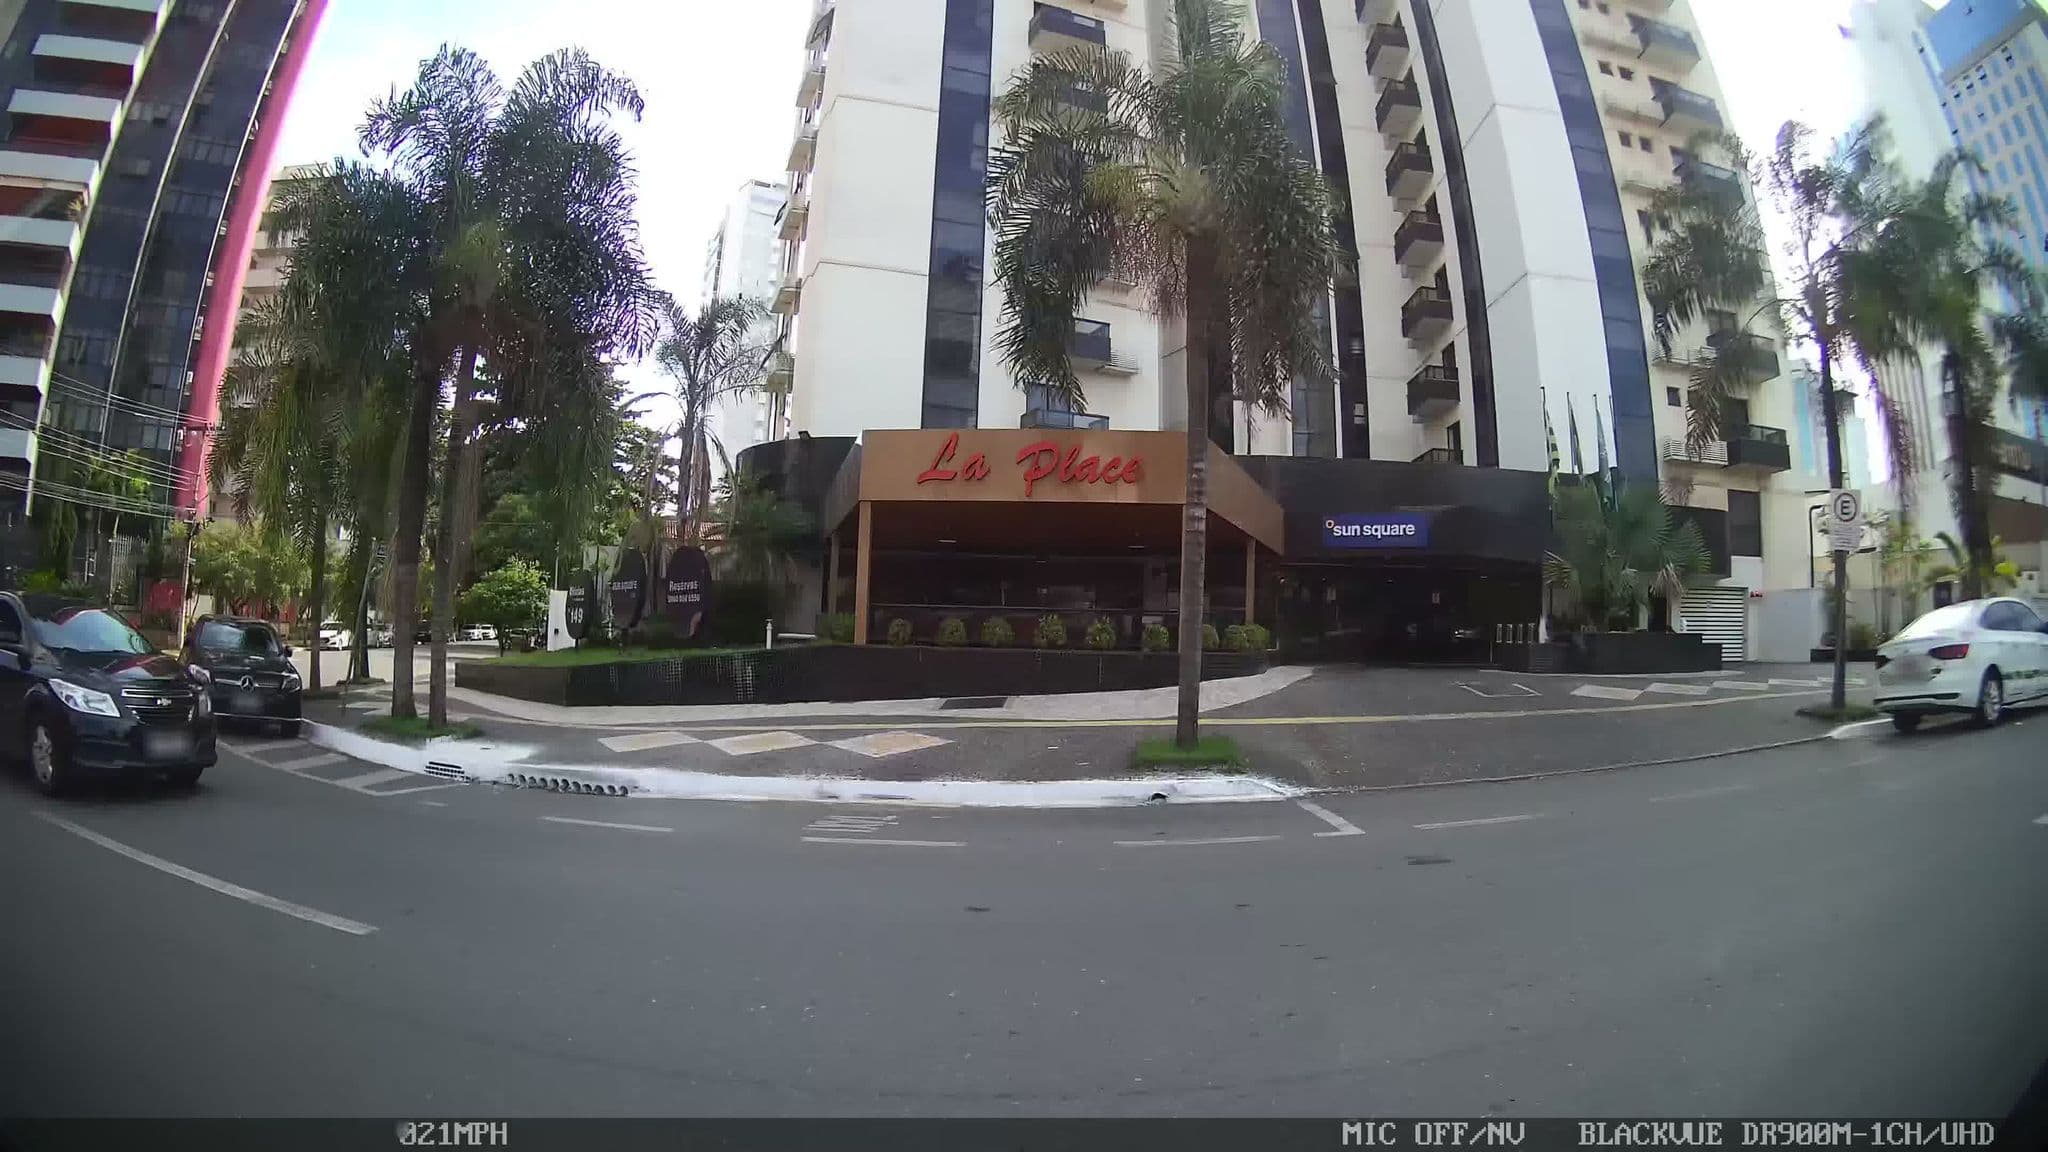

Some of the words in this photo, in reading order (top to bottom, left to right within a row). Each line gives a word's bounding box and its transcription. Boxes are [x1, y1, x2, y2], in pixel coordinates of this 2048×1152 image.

[917, 432, 990, 484] La
[1016, 440, 1143, 497] Place
[1841, 500, 1850, 515] E
[1362, 524, 1415, 539] square
[669, 580, 698, 592] Reservas
[570, 607, 584, 624] 149
